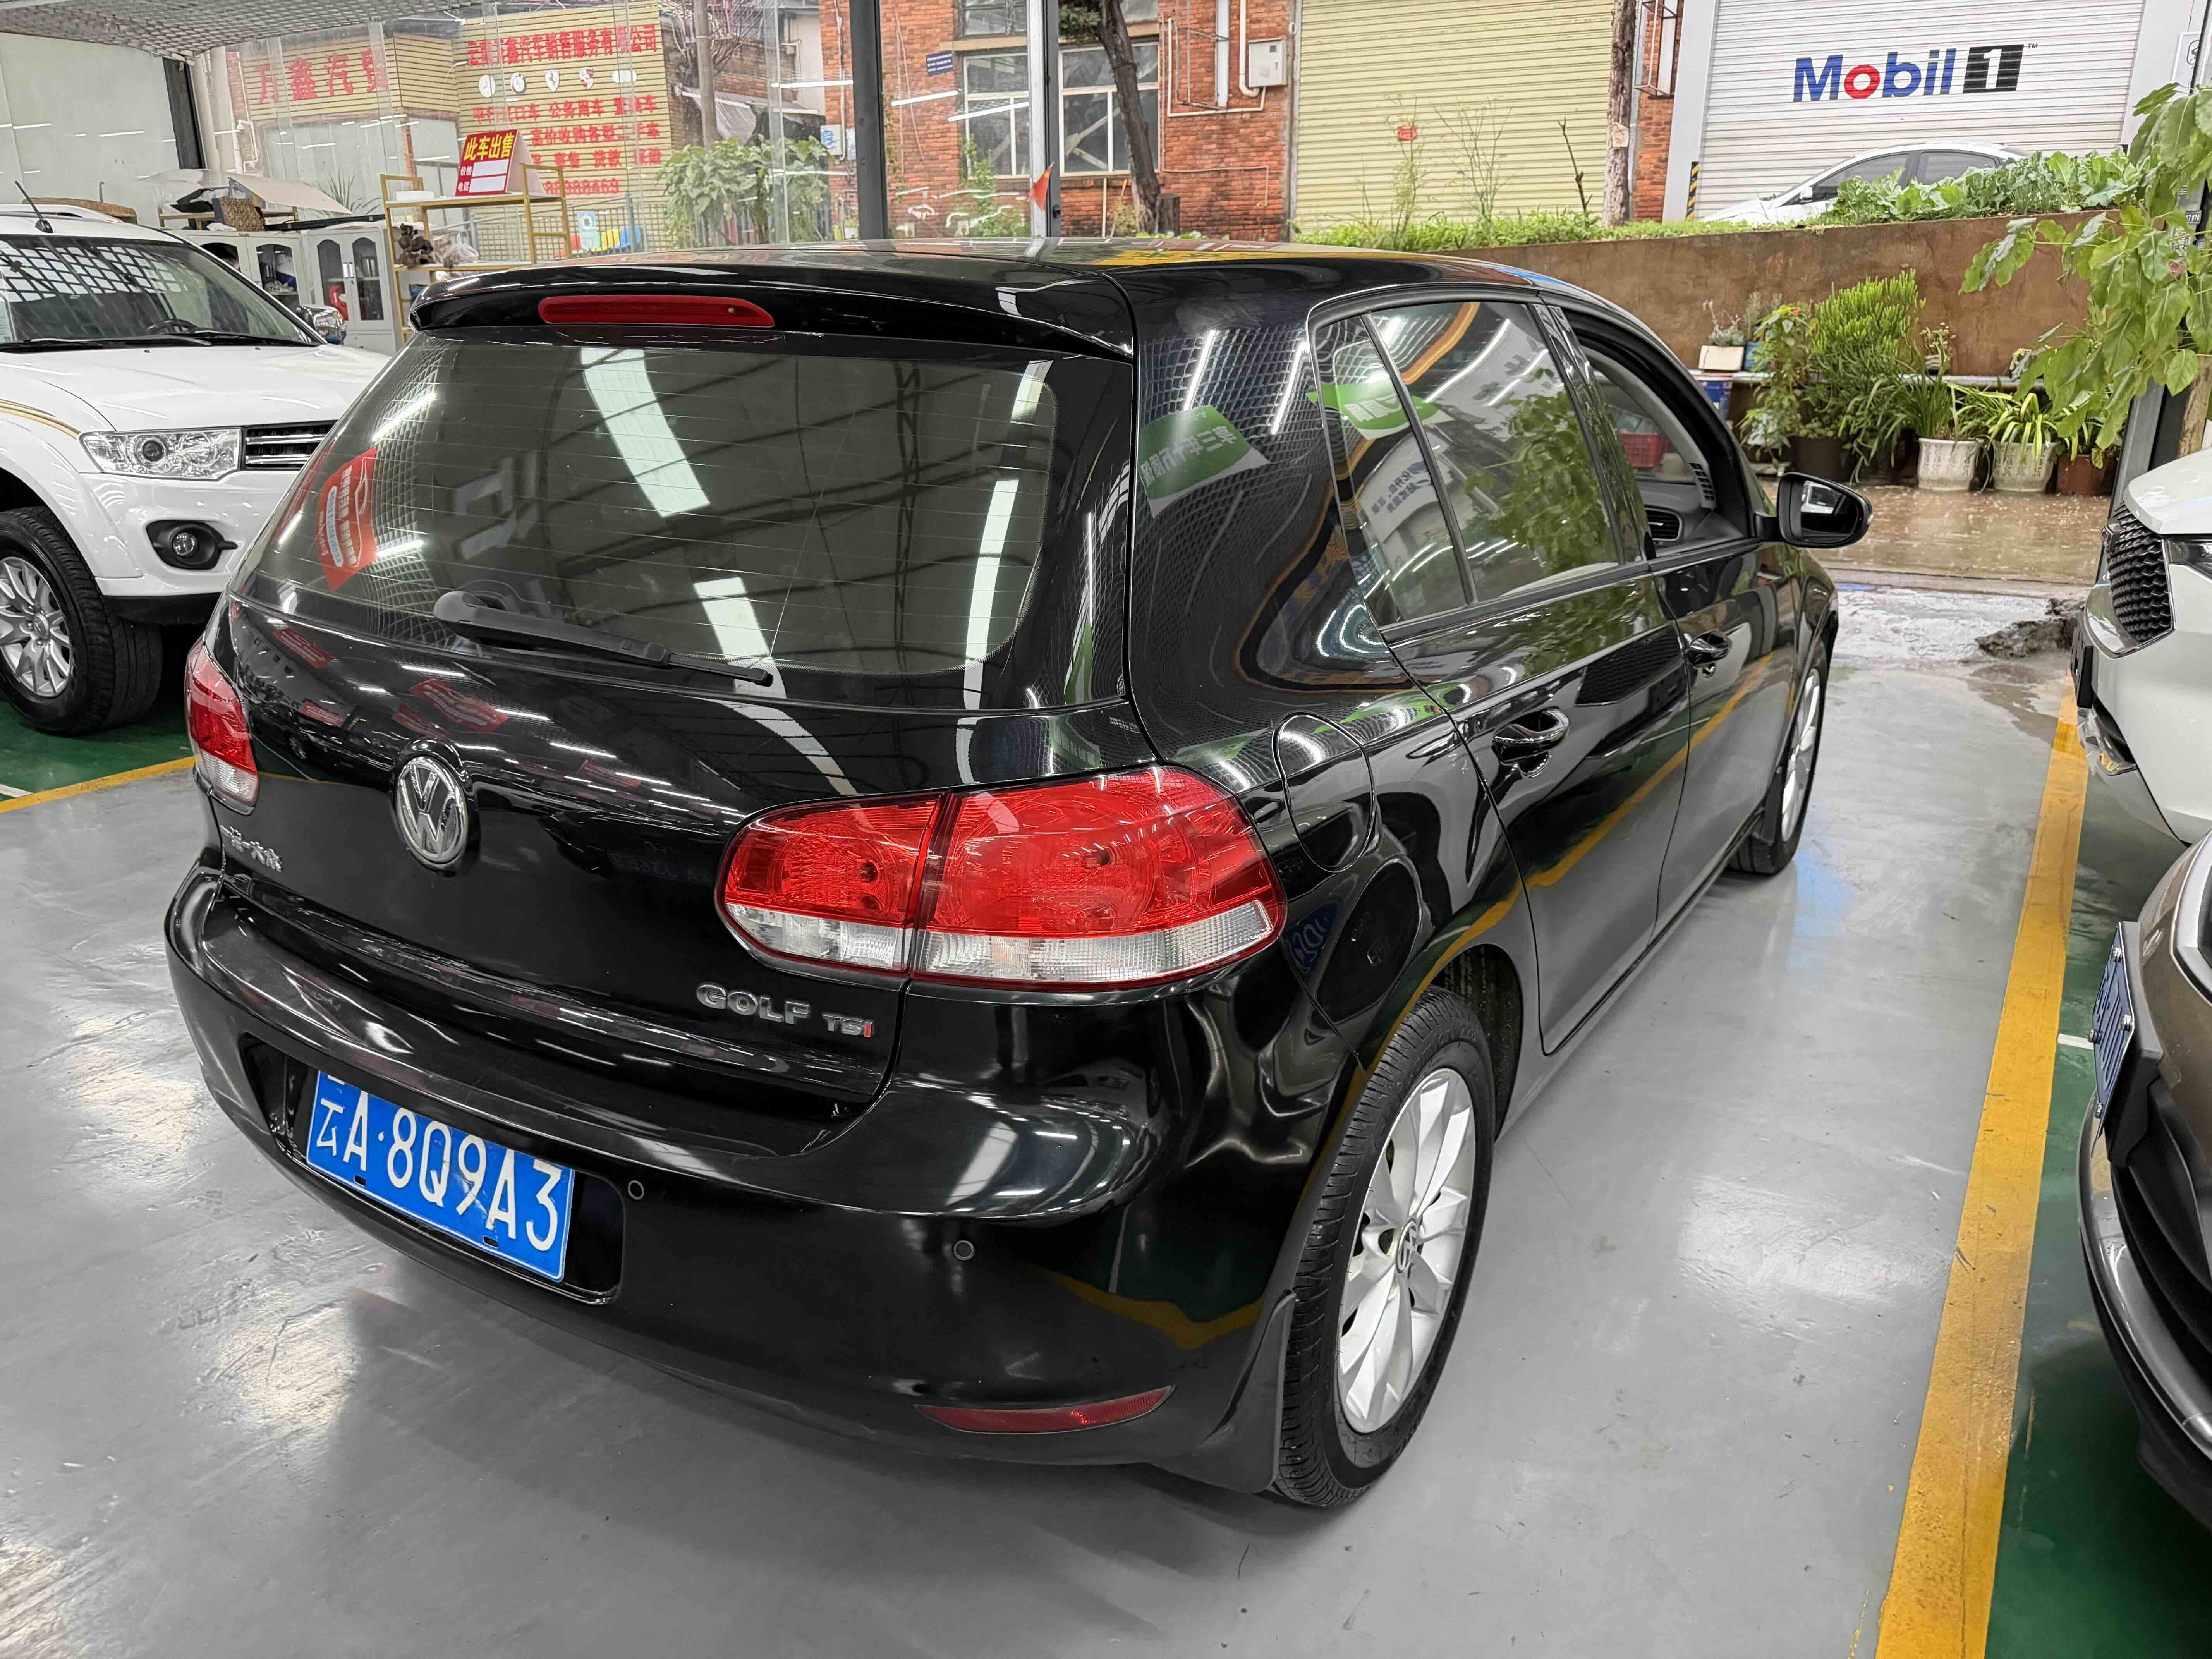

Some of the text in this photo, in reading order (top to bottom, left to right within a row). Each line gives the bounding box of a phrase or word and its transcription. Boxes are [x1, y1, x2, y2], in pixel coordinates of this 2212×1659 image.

[1793, 48, 1957, 102] Mobil
[464, 132, 515, 160] 此车出售
[460, 166, 472, 176] 价格
[458, 182, 469, 192] 电话
[696, 982, 872, 1037] GOLF TSI
